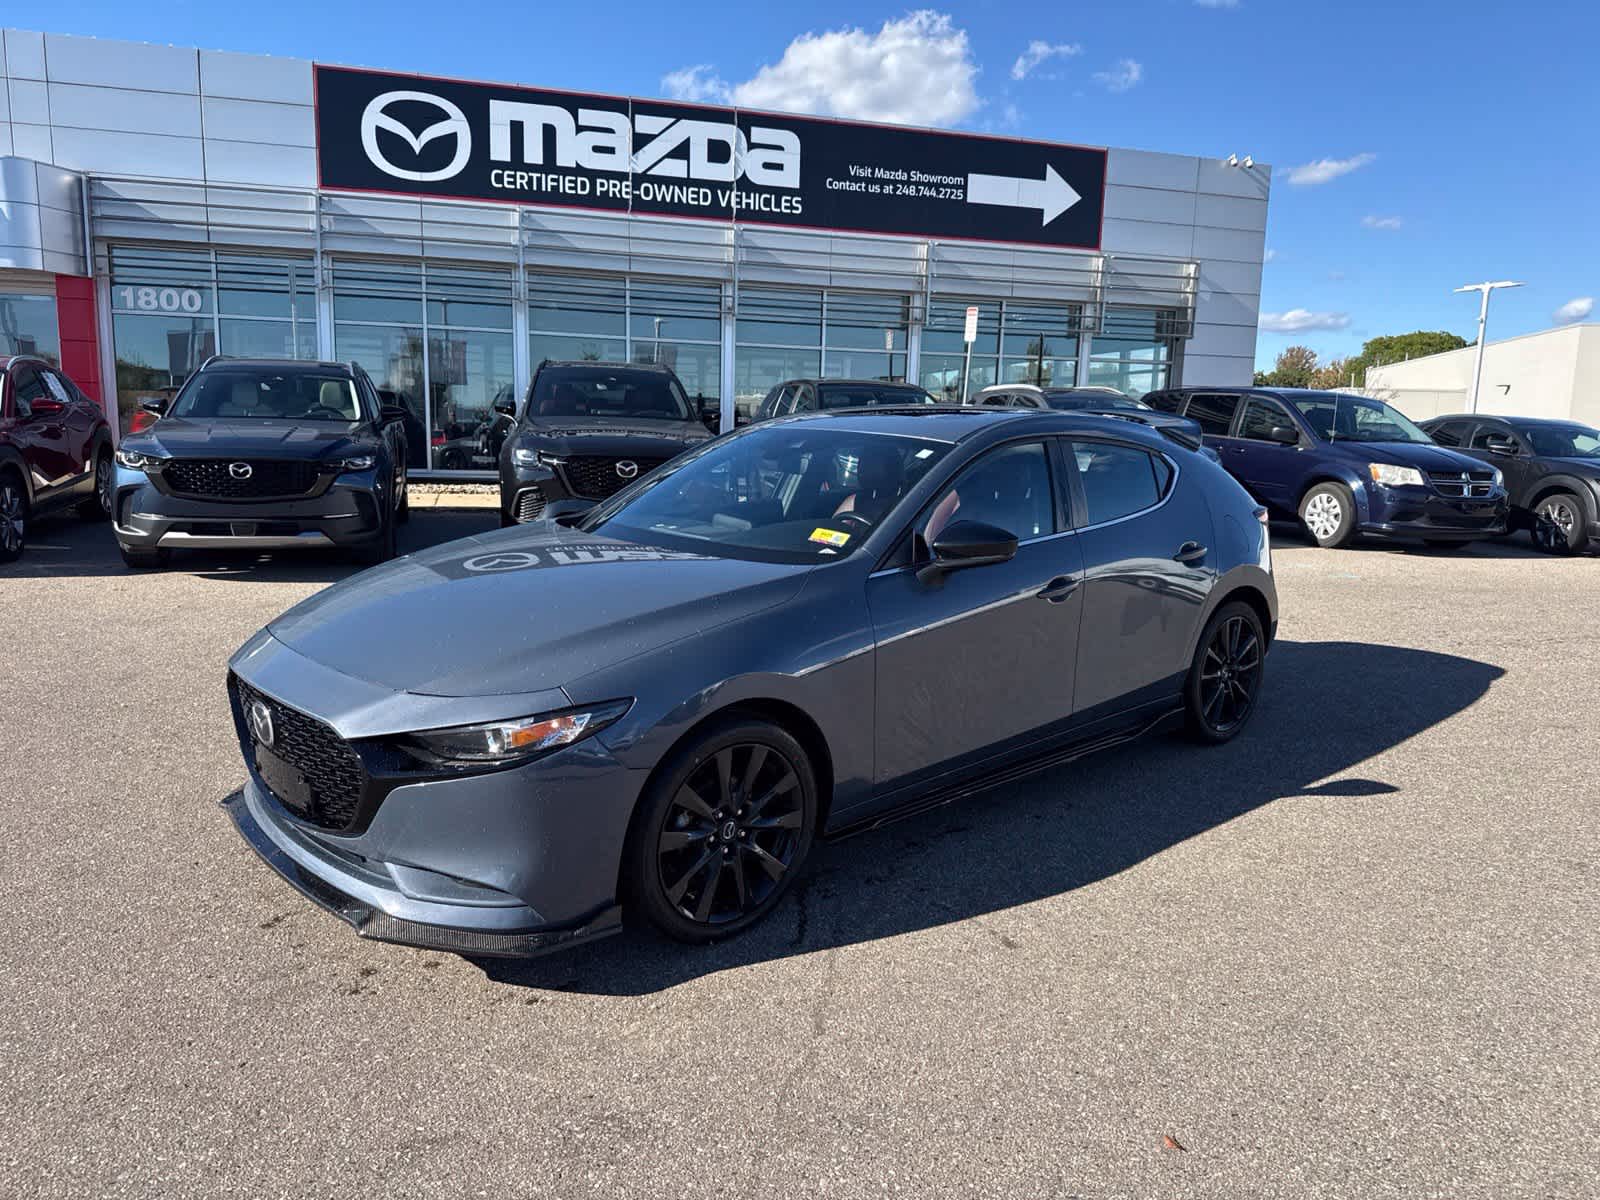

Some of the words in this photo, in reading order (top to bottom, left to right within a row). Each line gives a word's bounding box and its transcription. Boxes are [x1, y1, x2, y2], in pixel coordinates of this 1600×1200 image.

[849, 164, 872, 177] Visit
[874, 168, 908, 181] Mazda
[910, 170, 964, 186] Showroom
[490, 169, 590, 195] CERTIFIED
[596, 179, 712, 206] PRE-OWNED
[717, 189, 802, 214] VEHICLES
[826, 178, 866, 192] Contact
[868, 183, 881, 193] us
[883, 184, 893, 195] at
[896, 184, 964, 200] 248.744.2725
[121, 287, 202, 312] 1800
